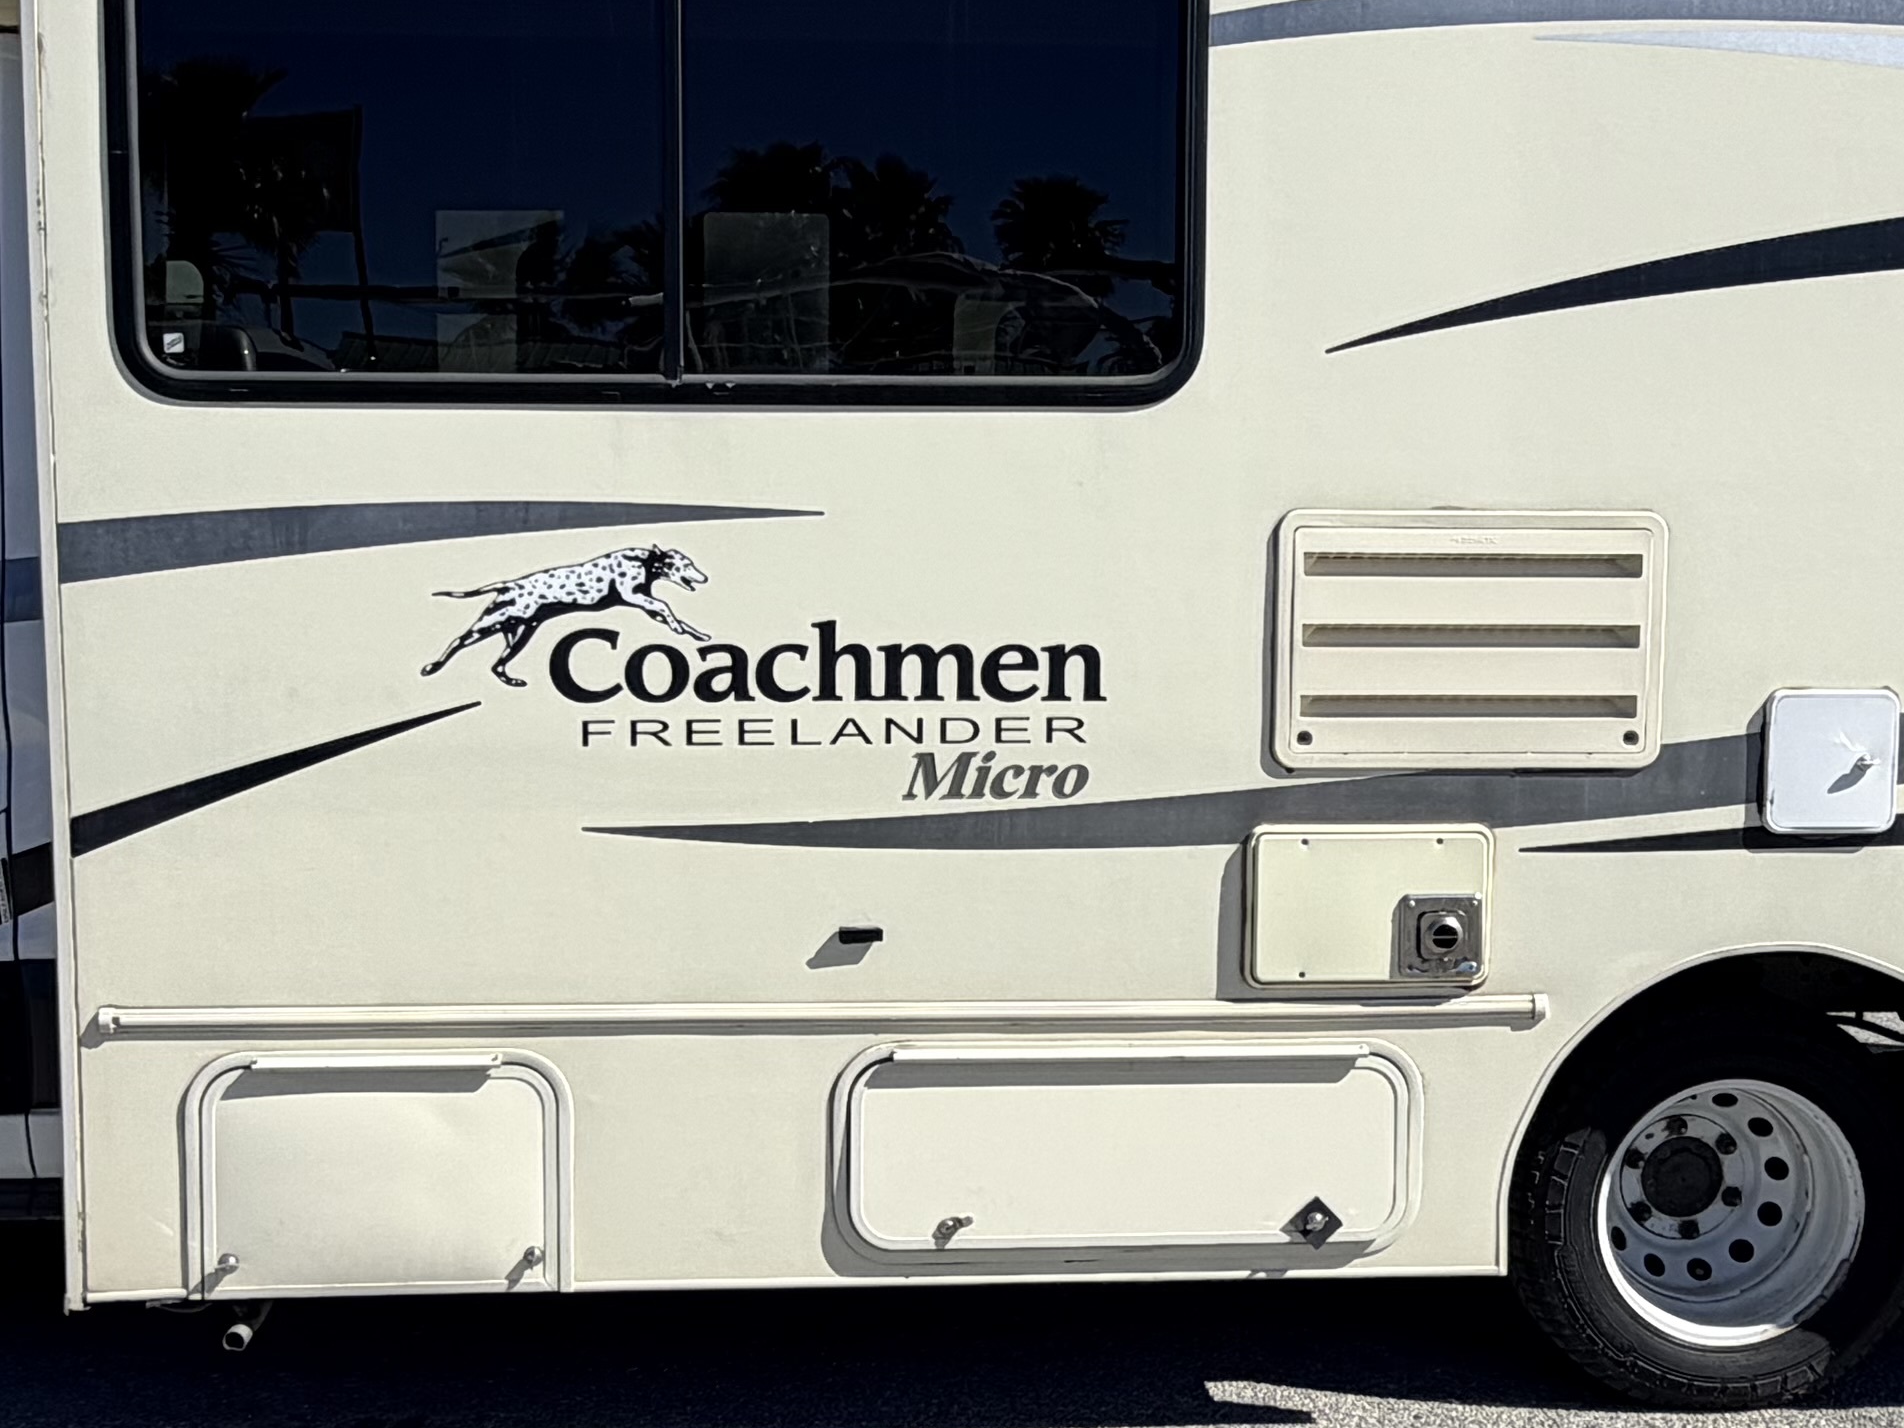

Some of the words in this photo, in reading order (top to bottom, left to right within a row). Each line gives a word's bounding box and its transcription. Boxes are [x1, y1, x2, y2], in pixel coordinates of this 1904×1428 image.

[548, 619, 1107, 704] Coachmen
[580, 716, 1088, 748] FREELANDER
[901, 750, 1090, 801] Micro
